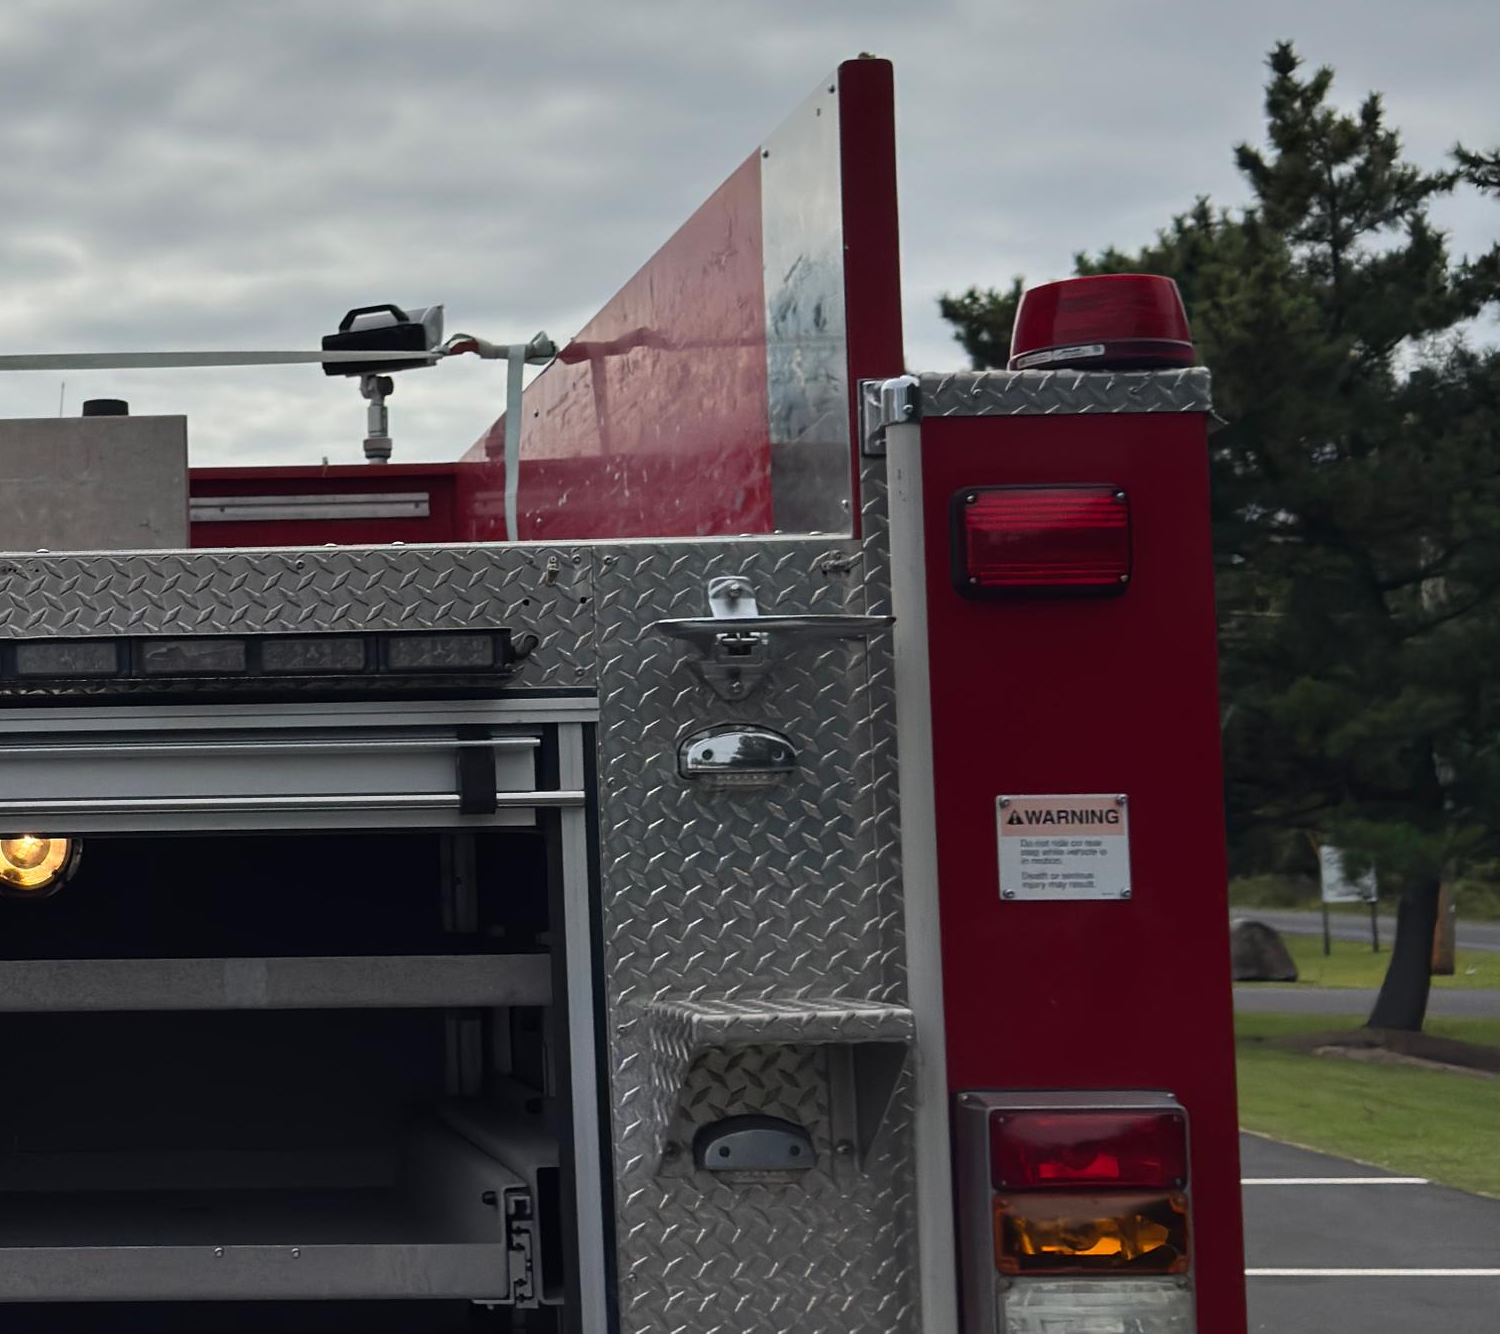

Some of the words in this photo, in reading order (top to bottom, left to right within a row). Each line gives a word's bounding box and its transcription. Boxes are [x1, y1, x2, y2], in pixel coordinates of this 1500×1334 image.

[1024, 809, 1120, 825] WARNING
[1020, 839, 1033, 847] Do
[1021, 871, 1048, 880] Death
[1022, 881, 1046, 890] injury
[1048, 882, 1067, 890] may
